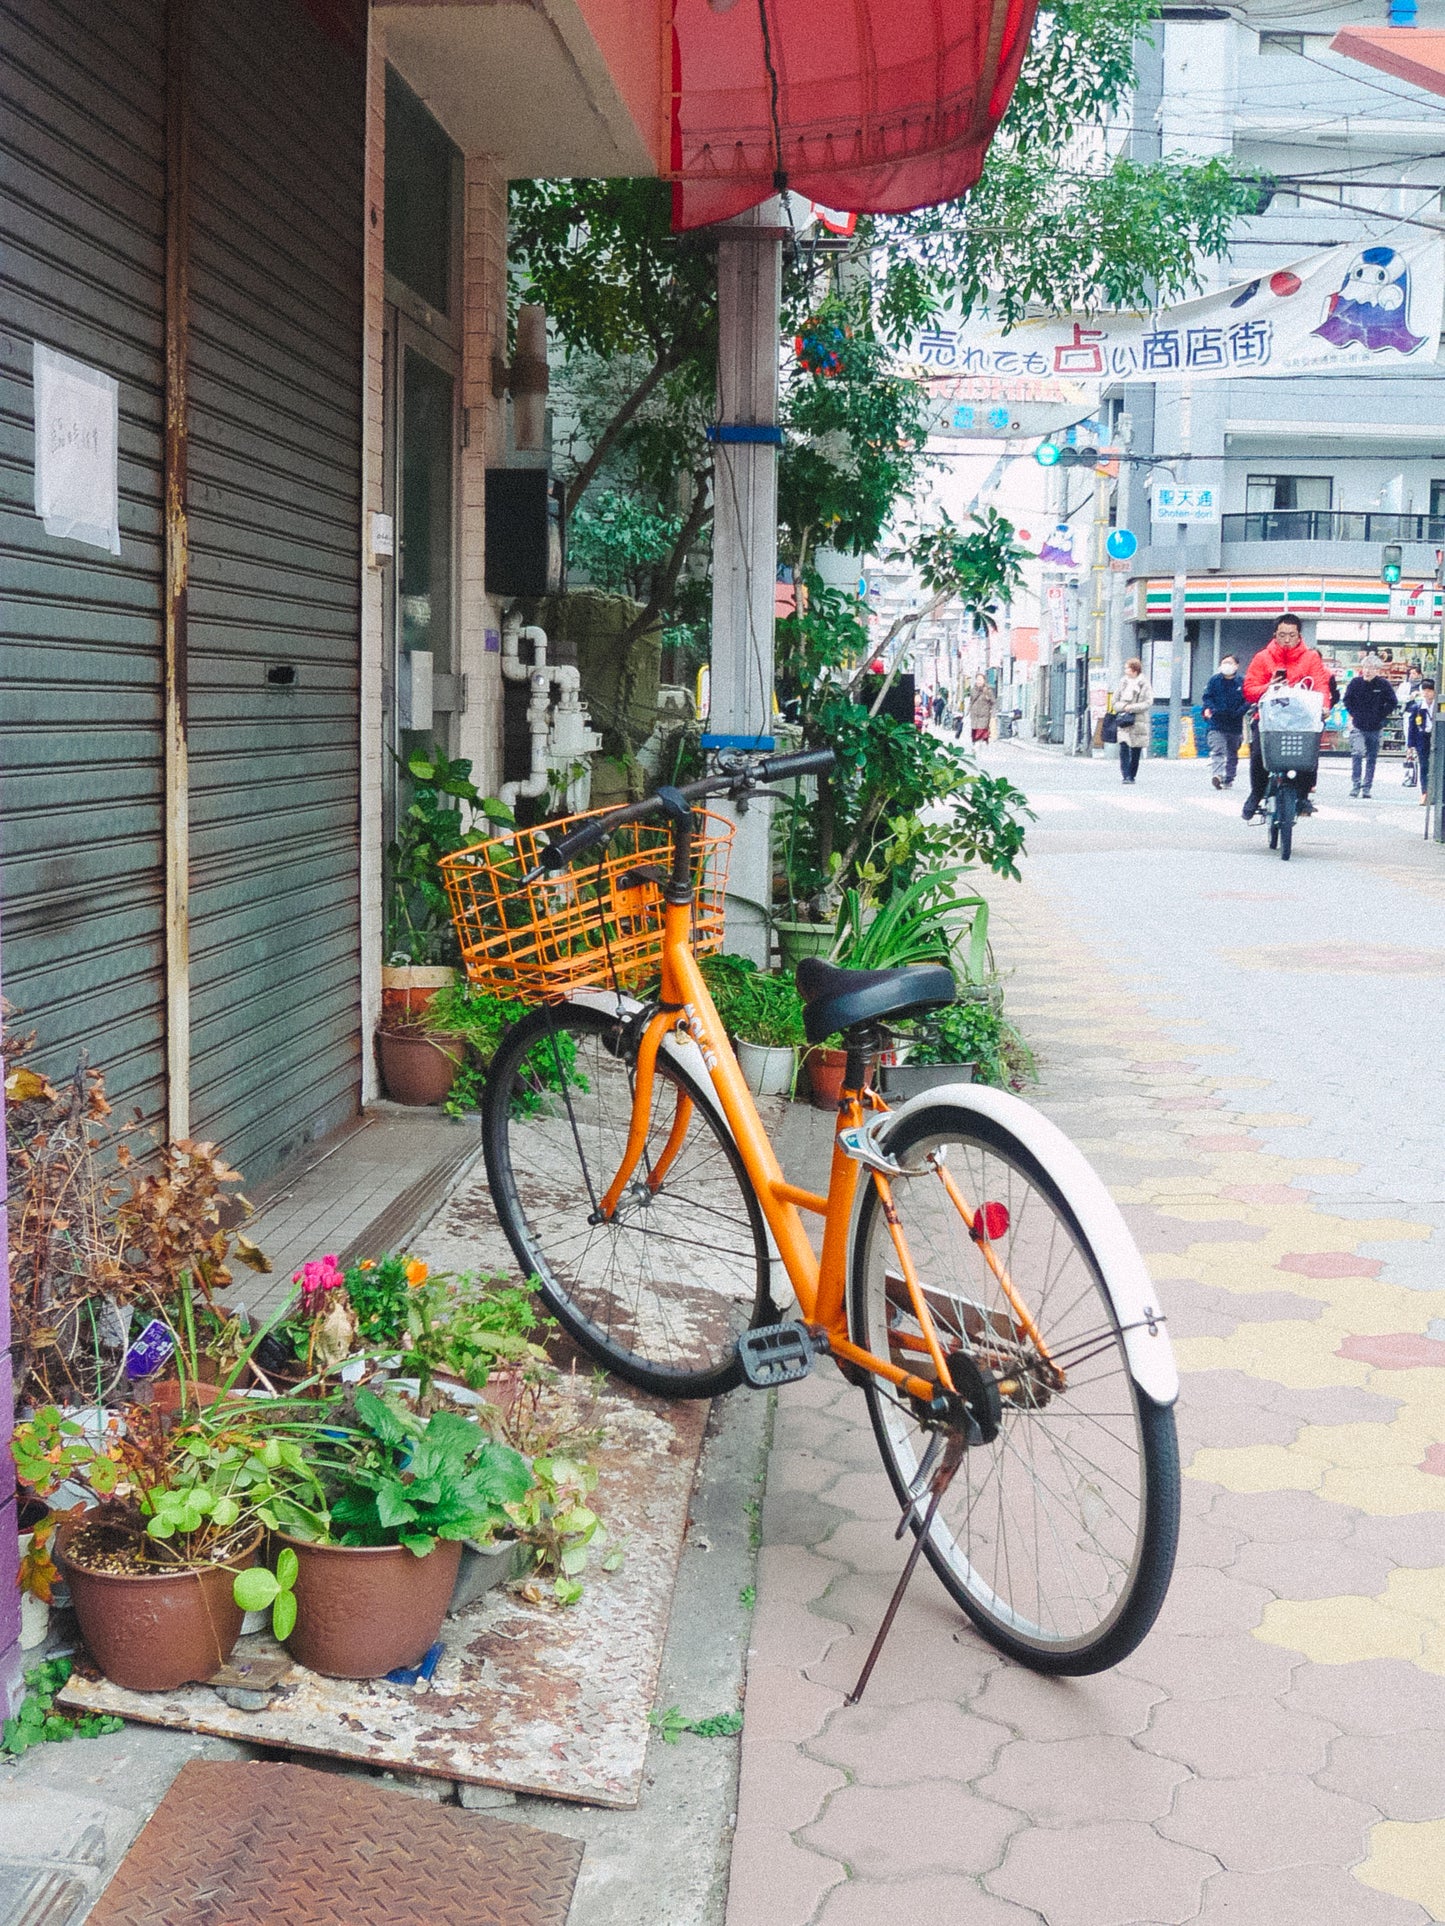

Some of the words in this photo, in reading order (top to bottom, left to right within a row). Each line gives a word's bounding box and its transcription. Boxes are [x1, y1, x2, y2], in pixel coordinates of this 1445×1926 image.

[919, 319, 1268, 375] 売れても占い商店街
